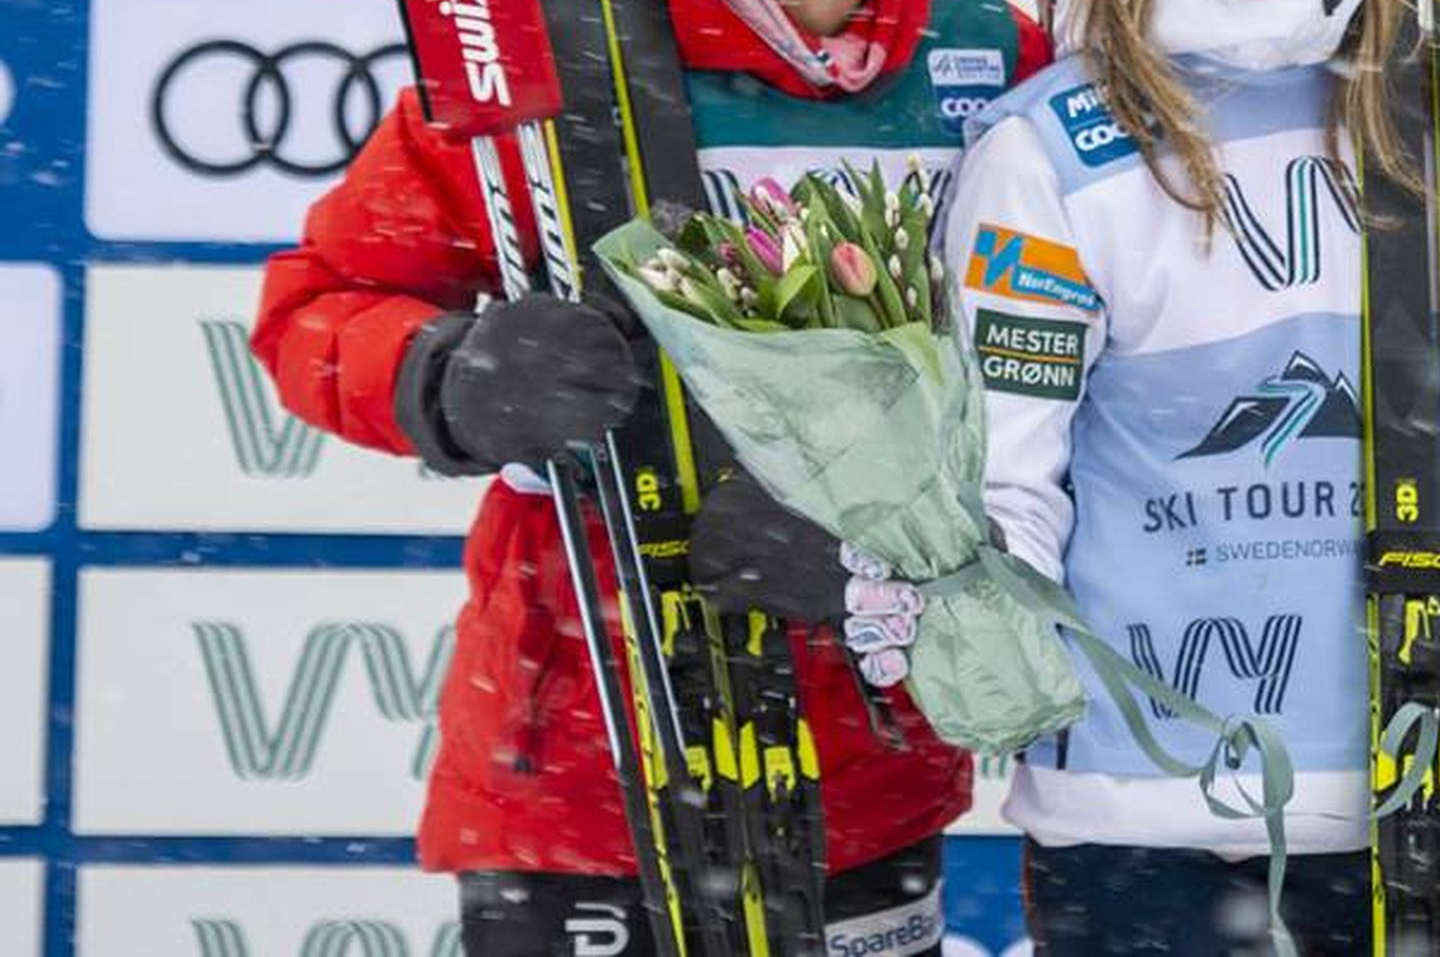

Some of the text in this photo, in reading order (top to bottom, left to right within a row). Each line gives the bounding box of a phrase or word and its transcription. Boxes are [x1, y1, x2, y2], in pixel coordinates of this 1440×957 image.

[985, 323, 1080, 355] MESTER
[983, 354, 1077, 387] GRØNN
[636, 472, 661, 511] 3D
[1142, 491, 1198, 534] SKI
[1216, 480, 1335, 523] TOUR
[1396, 483, 1419, 522] 3D
